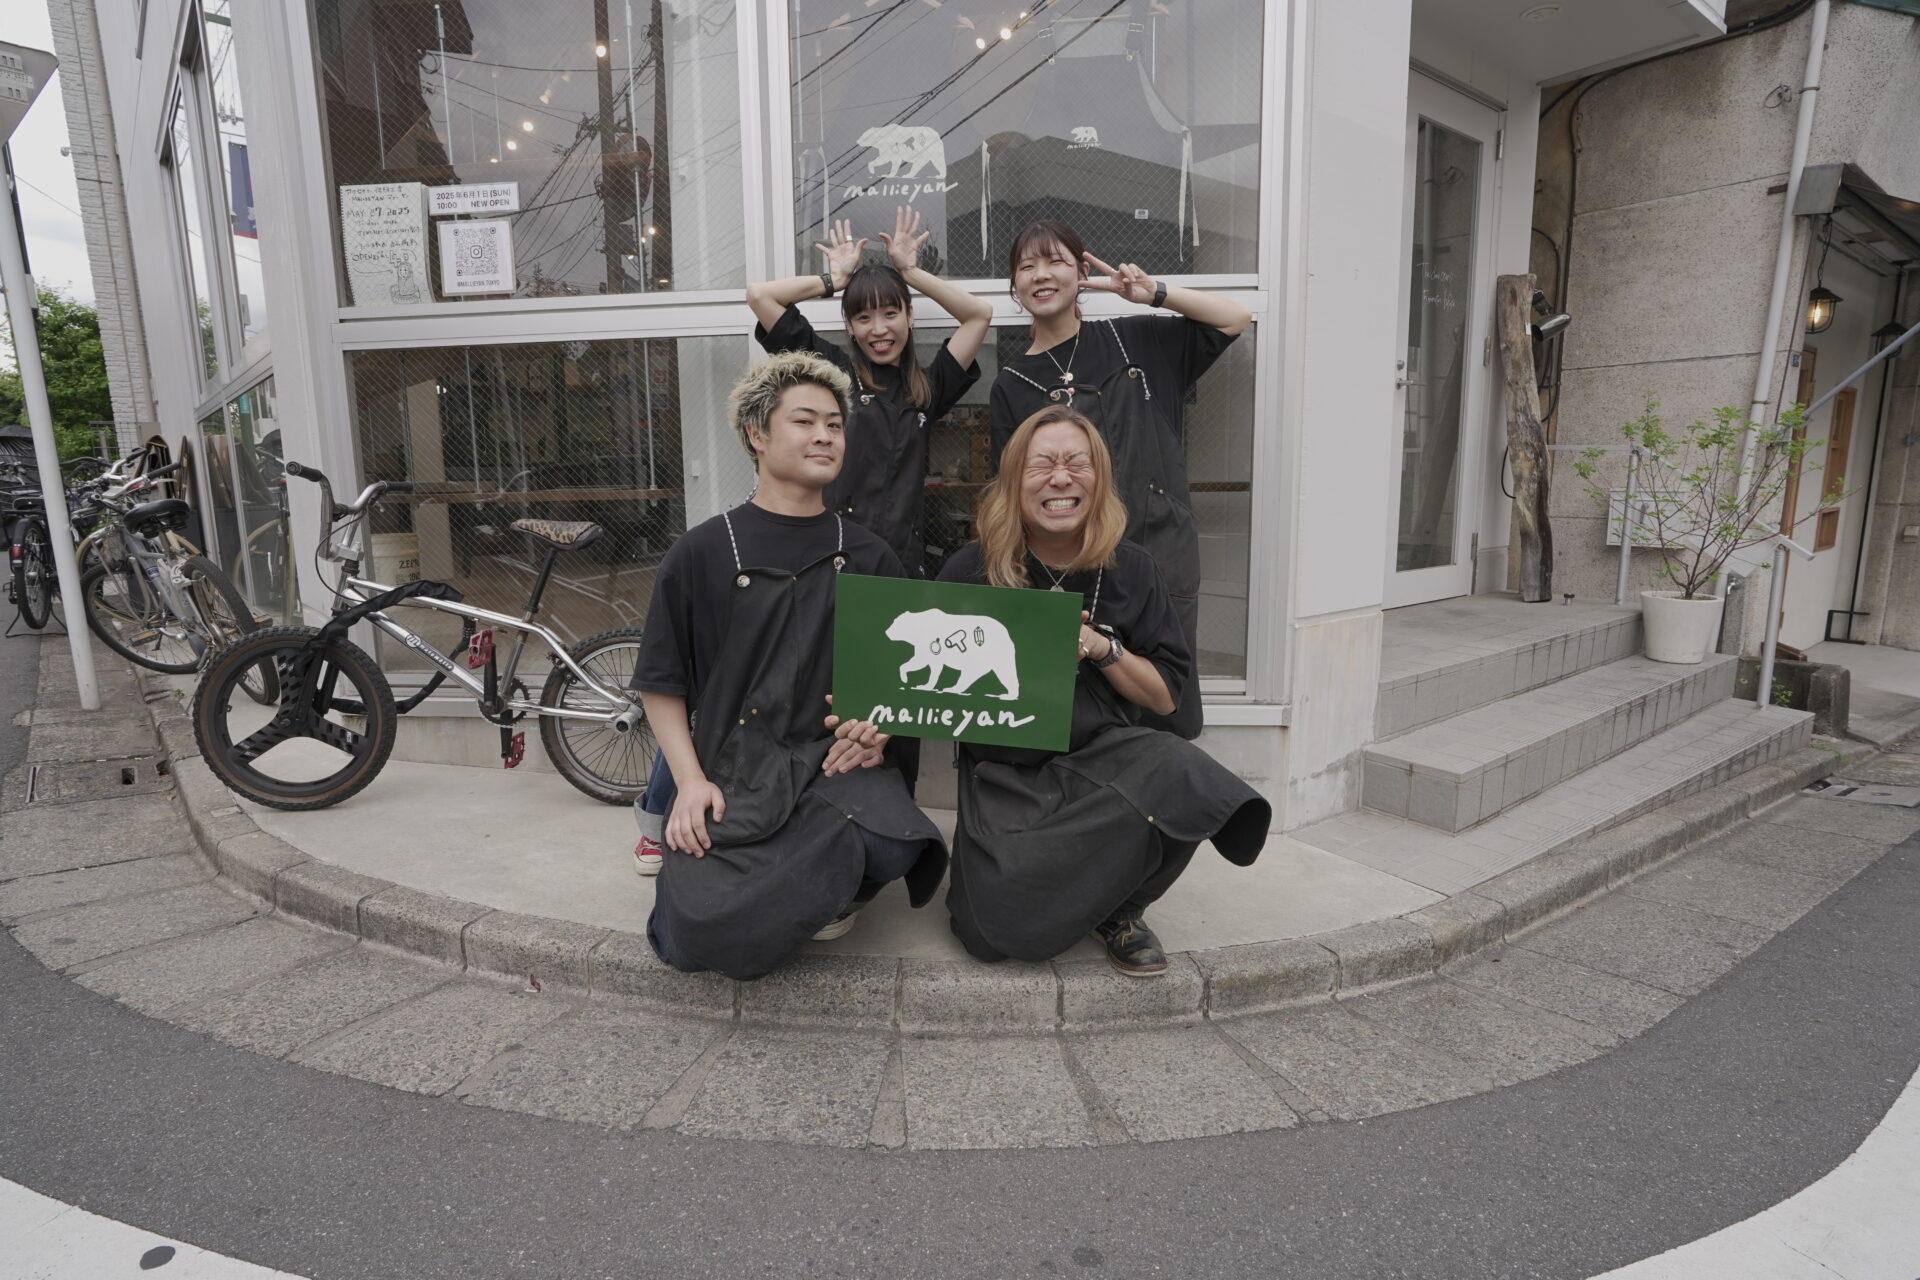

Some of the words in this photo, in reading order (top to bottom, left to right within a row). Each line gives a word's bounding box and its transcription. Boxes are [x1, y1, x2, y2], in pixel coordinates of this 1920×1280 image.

[843, 181, 959, 204] mallieyan
[437, 202, 458, 210] 10:00
[489, 199, 510, 207] OPEN
[867, 703, 1036, 737] mallieyan
